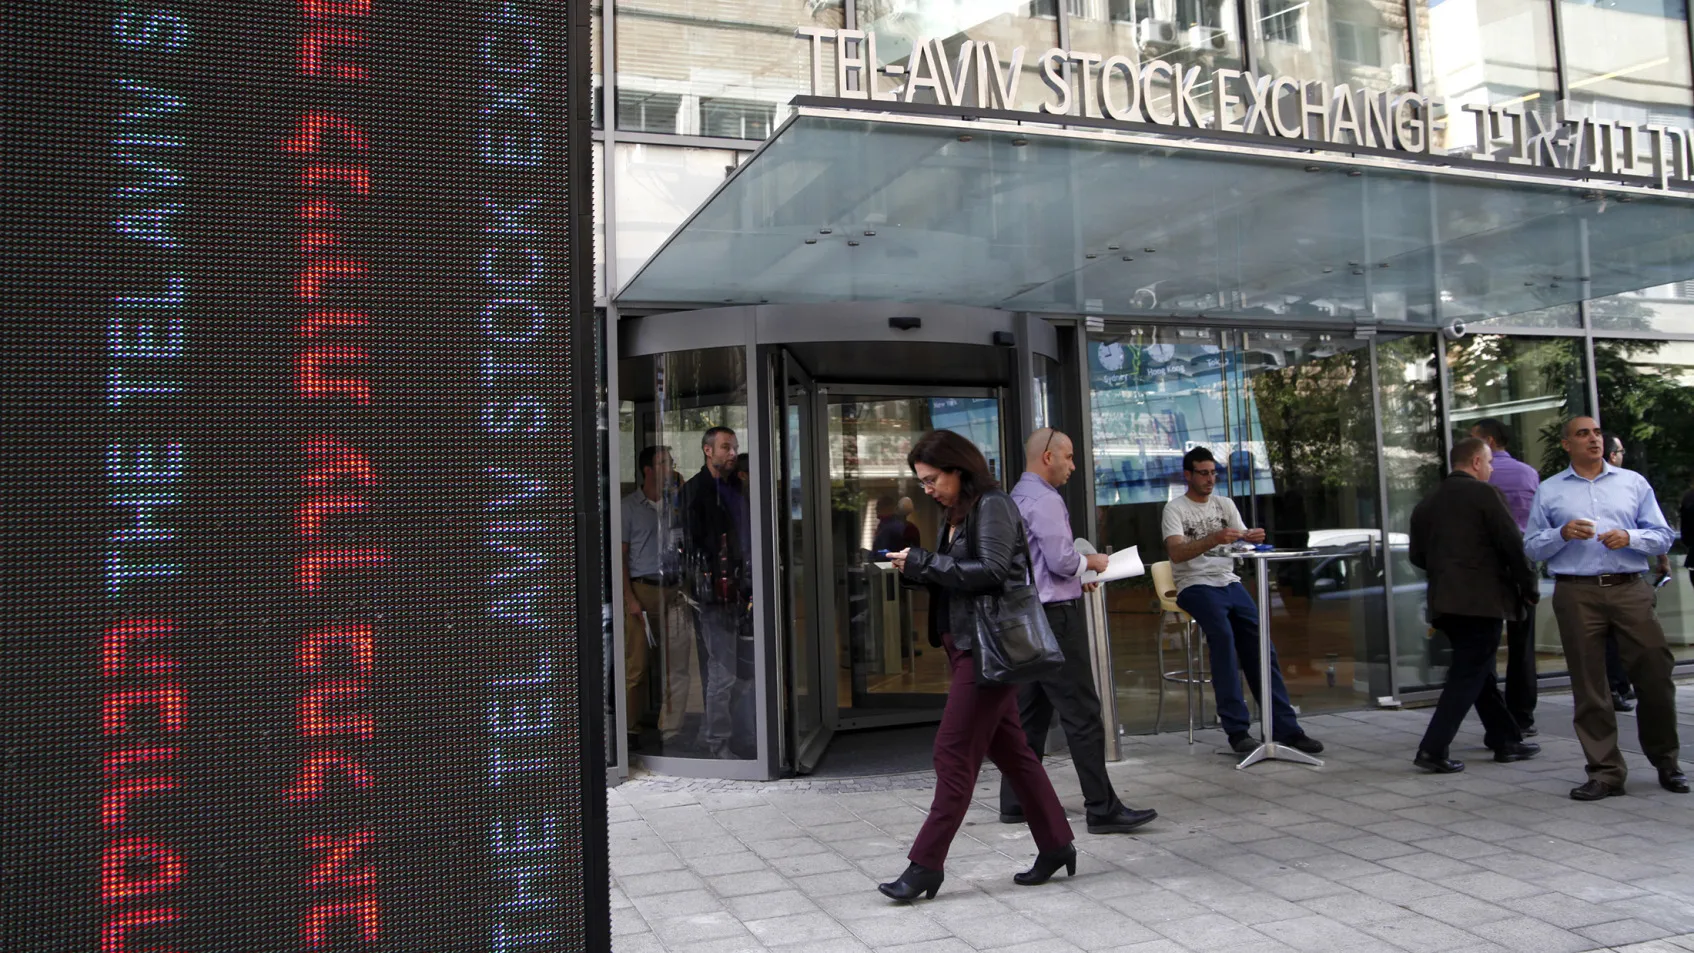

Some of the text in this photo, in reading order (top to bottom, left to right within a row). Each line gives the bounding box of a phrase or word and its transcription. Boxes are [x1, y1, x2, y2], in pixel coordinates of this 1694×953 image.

[110, 76, 187, 250] AVIV
[795, 27, 1449, 156] TEL-AVIV STOCK EXCHANGE
[1640, 122, 1694, 191] רך
[279, 111, 371, 405] לניירות
[479, 191, 547, 436] STOCK
[107, 272, 186, 410] TEL
[106, 441, 185, 597] THE
[297, 435, 391, 593] ערך
[485, 464, 549, 629] AVIV
[280, 622, 374, 803] בתל
[486, 649, 553, 786] TEL
[491, 811, 558, 953] THE
